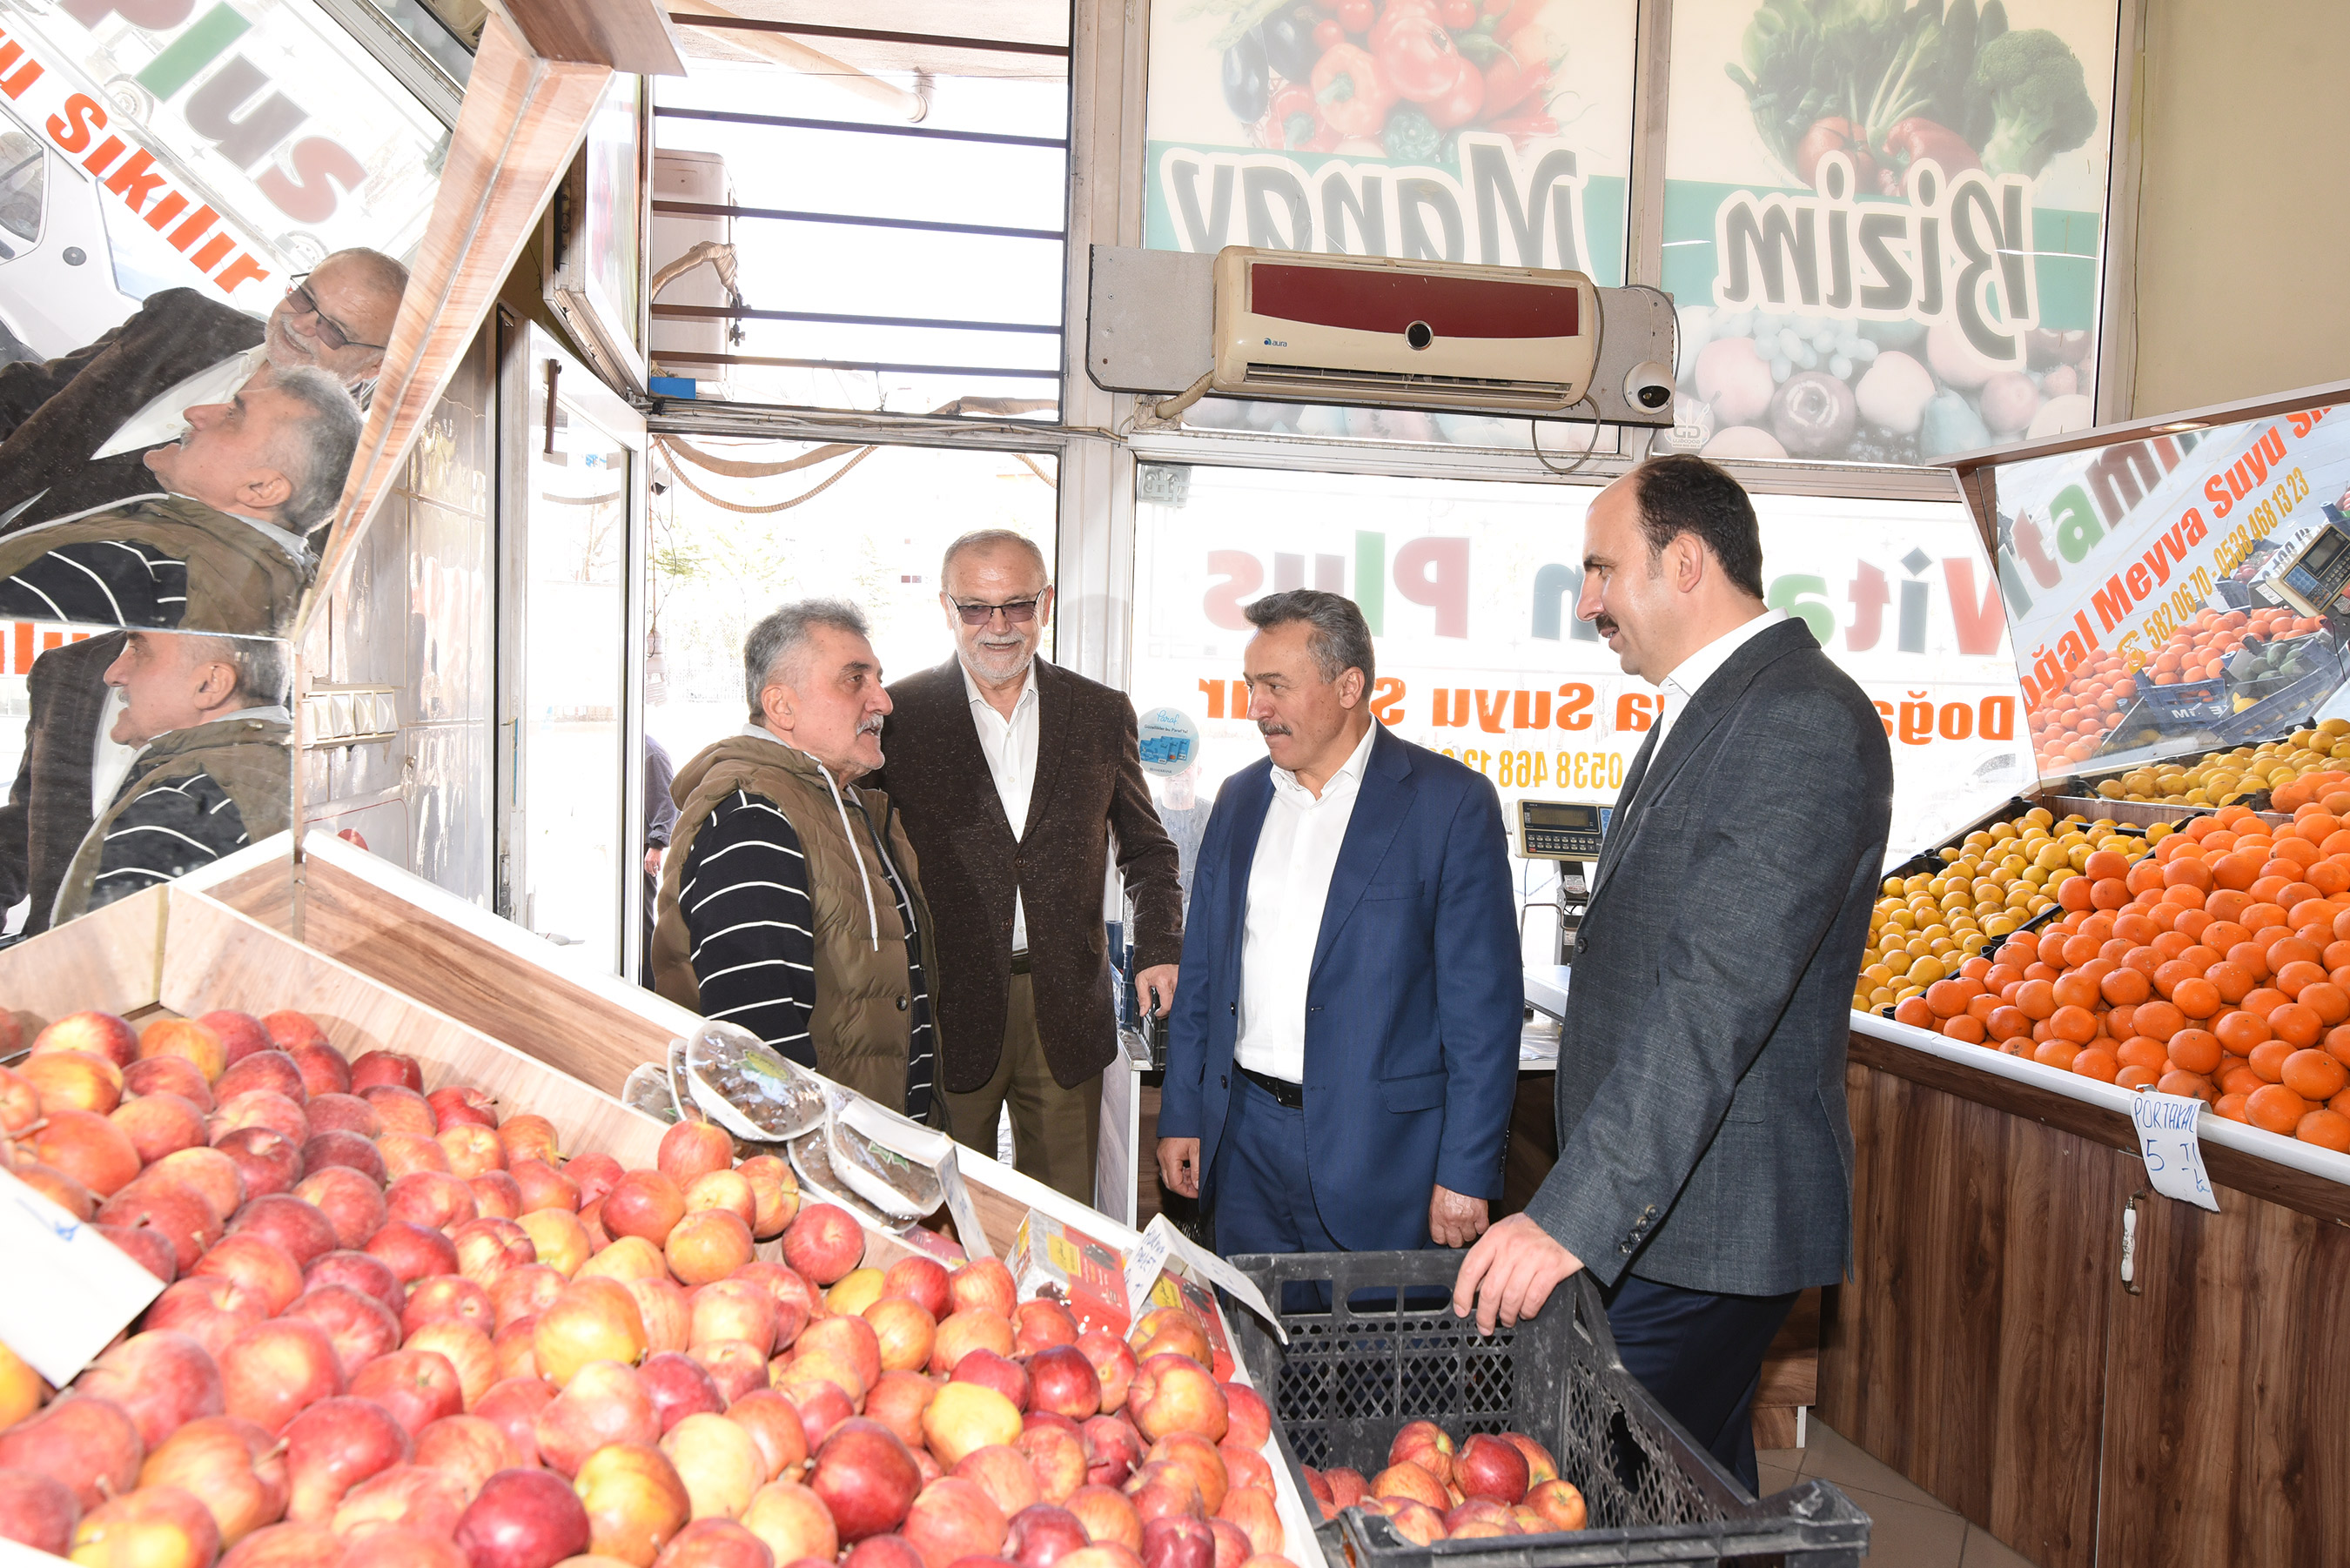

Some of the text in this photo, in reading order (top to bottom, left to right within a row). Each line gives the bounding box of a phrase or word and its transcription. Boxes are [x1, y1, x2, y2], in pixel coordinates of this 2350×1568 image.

[2019, 608, 2100, 715] oğal
[2091, 506, 2209, 634] Meyva
[2204, 425, 2288, 519] Suyu
[2142, 601, 2179, 650] 582
[2170, 582, 2198, 622] 06
[2187, 565, 2213, 604] 70
[2213, 523, 2254, 579] 0538
[2247, 498, 2279, 543] 468
[2272, 483, 2293, 519] 13
[2286, 466, 2310, 505] 23
[1156, 709, 1180, 726] Paraf
[2134, 1097, 2198, 1134] PORTAKAL
[2146, 1138, 2165, 1172] 5
